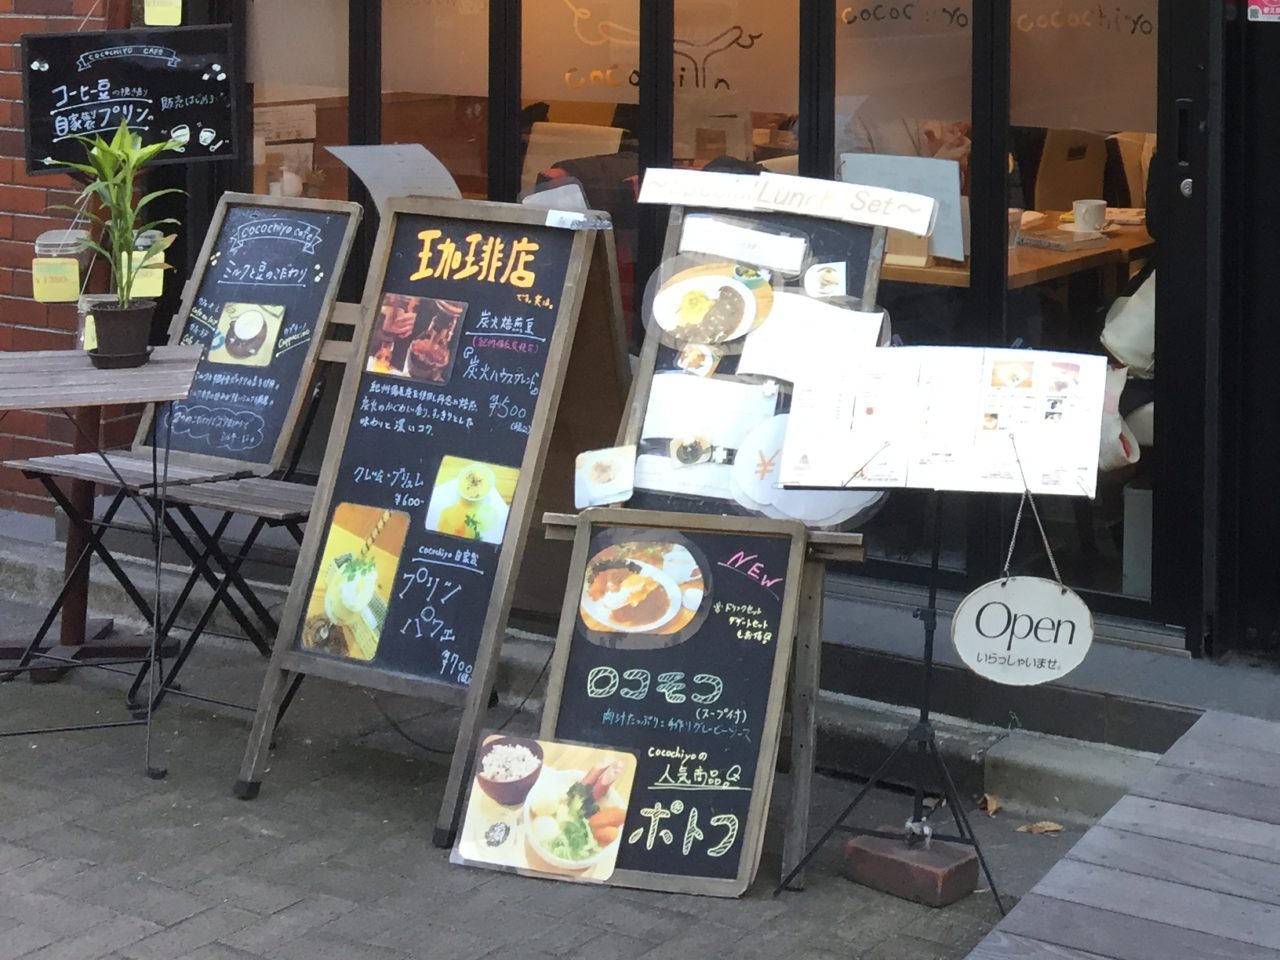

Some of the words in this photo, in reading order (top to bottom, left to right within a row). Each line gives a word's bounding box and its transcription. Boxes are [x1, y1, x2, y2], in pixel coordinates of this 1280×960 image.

[409, 228, 541, 288] 珈琲店
[399, 566, 463, 605] プリン
[726, 550, 784, 588] NEW
[974, 600, 1076, 652] Open
[586, 665, 724, 705] ロコモコ
[627, 799, 739, 858] ポトフ
